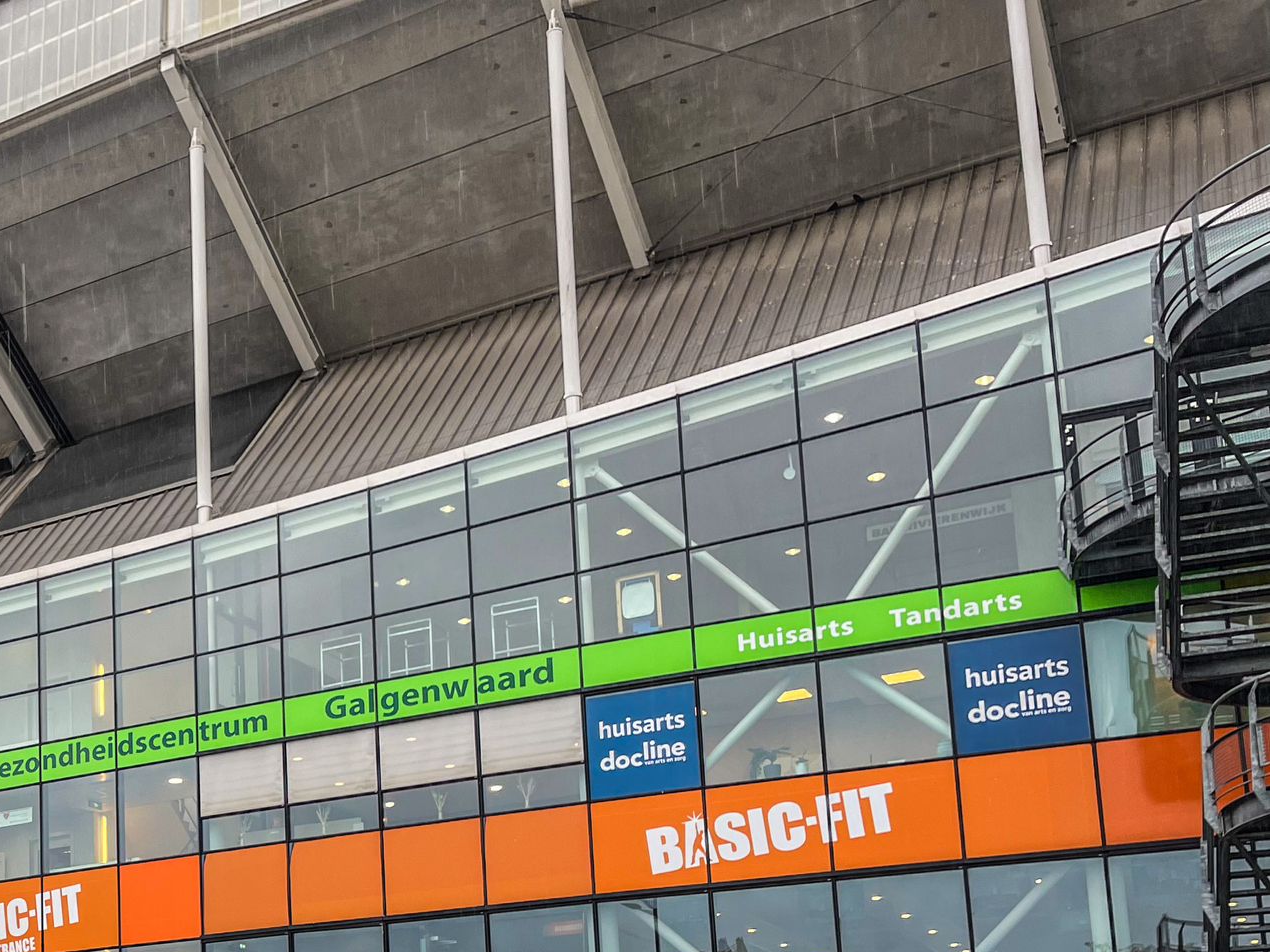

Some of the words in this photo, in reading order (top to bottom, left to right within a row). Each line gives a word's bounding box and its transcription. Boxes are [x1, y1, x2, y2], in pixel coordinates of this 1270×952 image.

[737, 616, 854, 652] Huisarts
[889, 592, 1023, 628] Tandarts
[324, 657, 554, 720] Galgenwaard
[965, 659, 1069, 688] huisarts
[968, 689, 1071, 724] docline
[598, 713, 685, 739] huisarts
[600, 740, 686, 771] docline
[645, 782, 893, 875] BASIC-FIT
